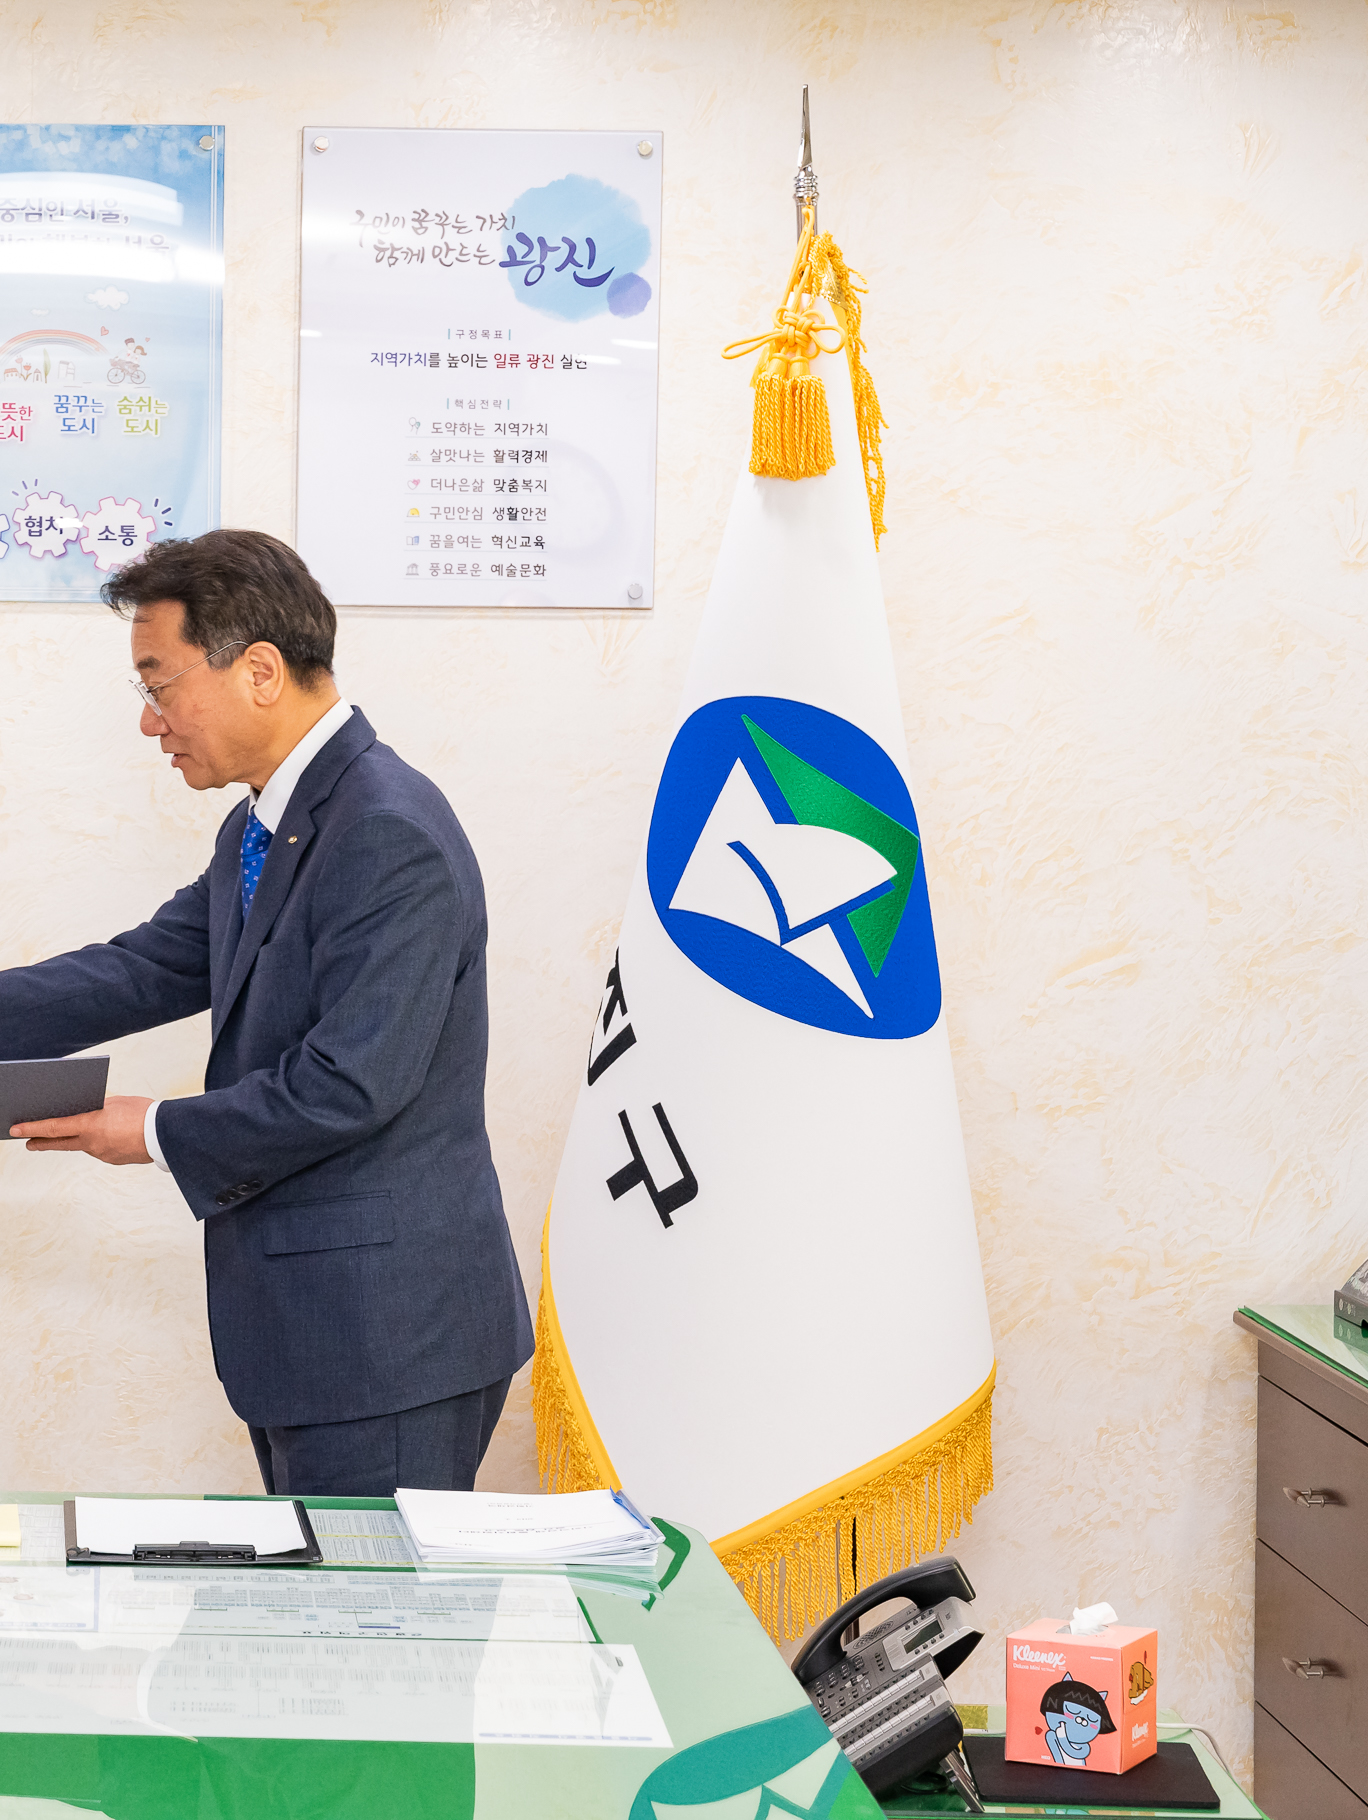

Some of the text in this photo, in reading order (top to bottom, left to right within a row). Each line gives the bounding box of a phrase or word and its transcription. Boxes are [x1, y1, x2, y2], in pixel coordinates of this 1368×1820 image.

[73, 198, 129, 224] 서울,
[411, 208, 473, 239] 꿈꾸는
[475, 212, 516, 232] 가치
[373, 232, 615, 287] 함께 만드는 광진
[455, 329, 503, 340] 구정목표
[370, 351, 441, 369] 지역가치를
[446, 353, 489, 369] 높이는
[493, 353, 521, 369] 일류
[526, 354, 555, 369] 광진
[53, 395, 104, 414] 꿈꾸는
[116, 396, 168, 416] 숨쉬는
[60, 418, 96, 435] 도시
[123, 419, 159, 436] 도시
[431, 422, 548, 437] 도약하는 지역가치
[430, 449, 548, 464] 살맛나는 활력경제
[431, 478, 547, 493] 더나은삶 맞춤복지
[430, 506, 547, 521] 구민안심 생활안전
[24, 516, 63, 537] 협치
[97, 525, 138, 546] 소통
[429, 534, 545, 550] 꿈을여는 혁신교육
[429, 563, 547, 578] 풍요로운 예술문화
[1013, 1645, 1066, 1668] Kleenex
